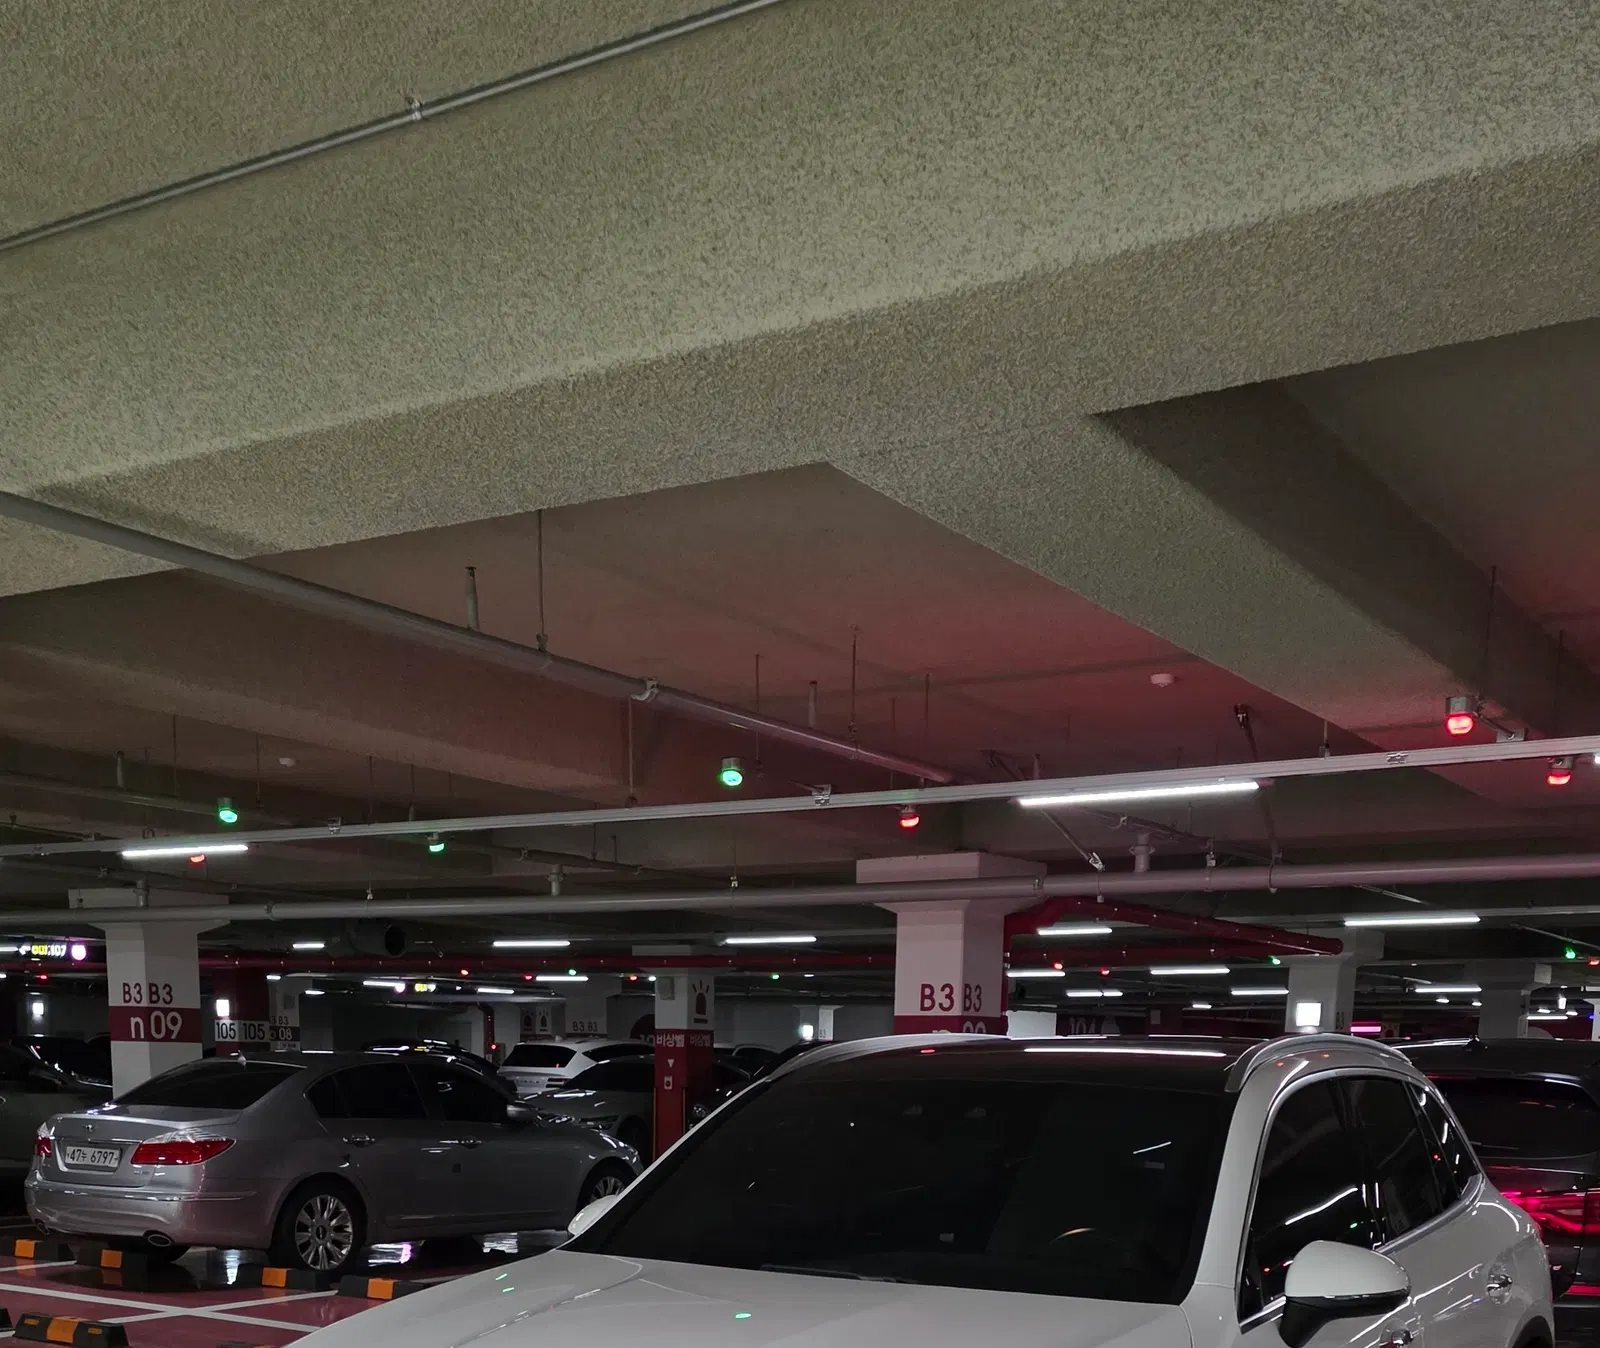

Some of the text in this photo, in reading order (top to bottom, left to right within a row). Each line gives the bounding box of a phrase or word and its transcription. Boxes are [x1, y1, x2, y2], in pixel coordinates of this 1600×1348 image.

[122, 982, 142, 1004] B3
[148, 982, 173, 1005] B3
[920, 983, 954, 1012] B3
[964, 983, 982, 1012] B3
[150, 1010, 182, 1039] 09
[216, 1022, 236, 1040] 105
[242, 1023, 266, 1040] 105
[278, 1027, 293, 1041] 08
[656, 1033, 685, 1048] 비상벨
[90, 1150, 115, 1165] 6797
